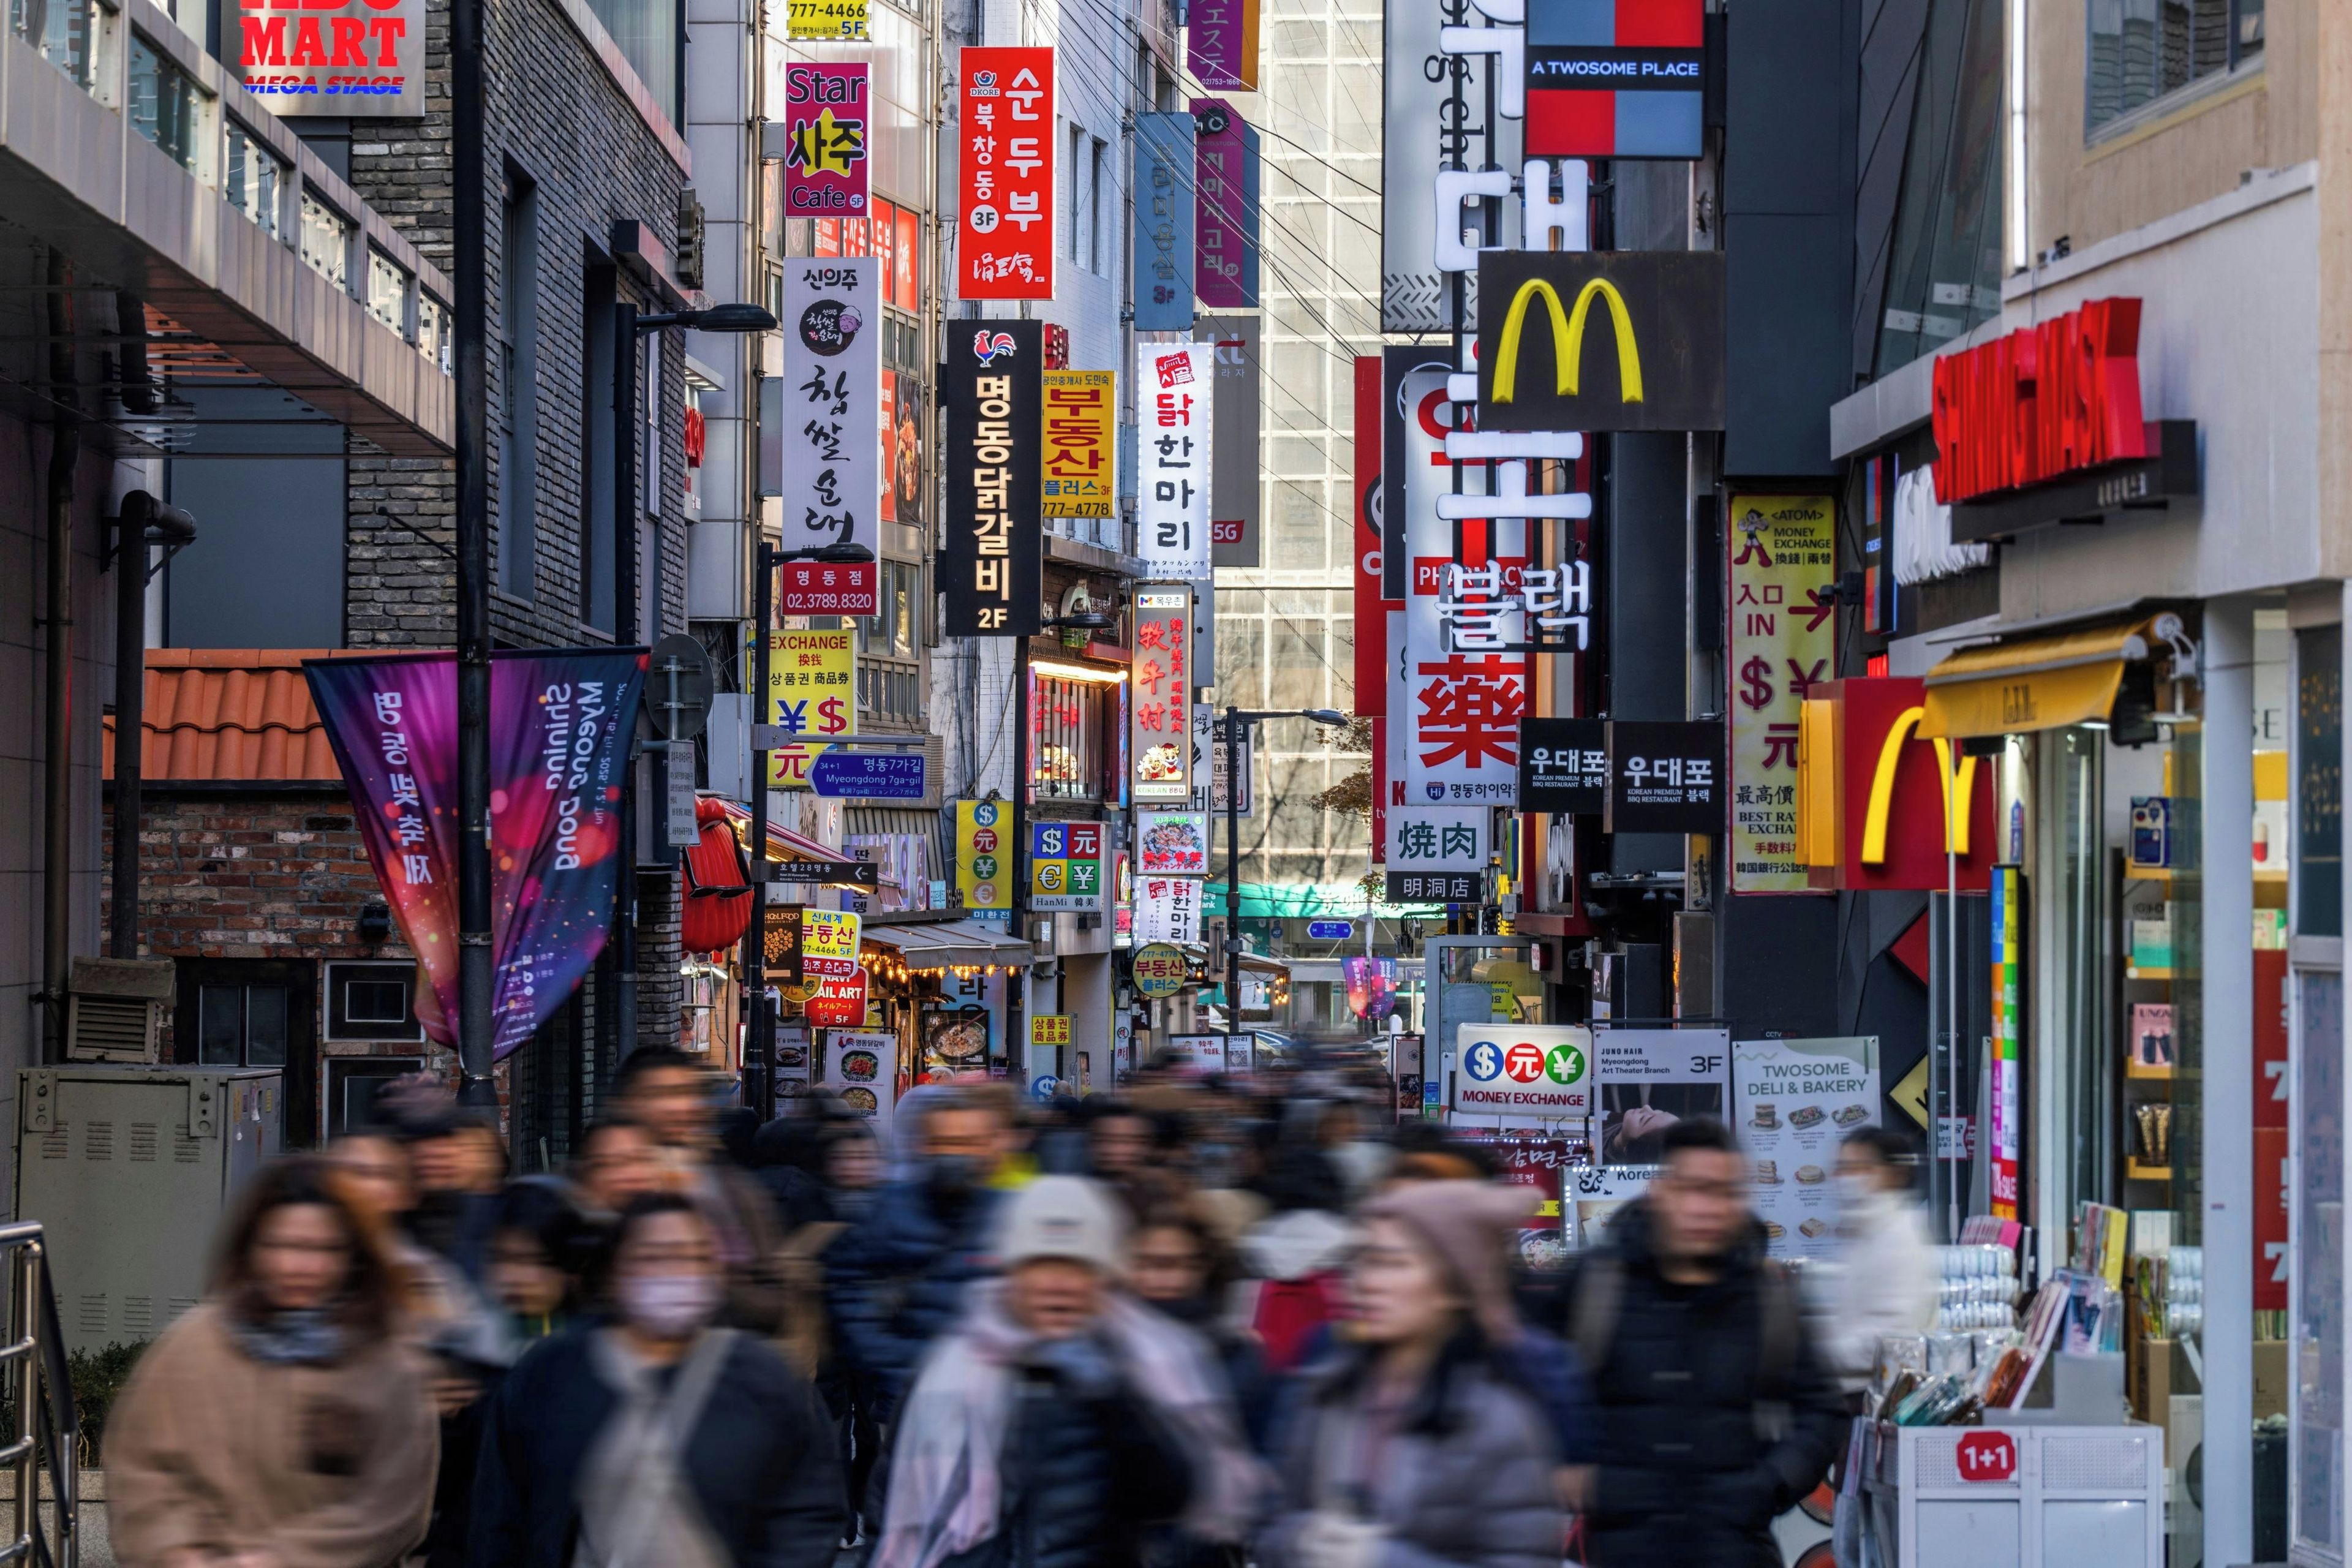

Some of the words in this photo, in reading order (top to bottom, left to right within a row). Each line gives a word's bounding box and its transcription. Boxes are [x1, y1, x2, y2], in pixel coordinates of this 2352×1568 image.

[790, 3, 865, 18] 777-4466
[841, 21, 864, 35] 5F
[239, 17, 406, 67] MART
[1532, 62, 1545, 75] A
[1548, 62, 1637, 75] TWOSOME
[1642, 62, 1698, 76] PLACE
[241, 75, 318, 95] MEGA
[324, 75, 405, 95] STAGE
[786, 68, 866, 104] Star
[970, 88, 1000, 96] DKORE
[786, 119, 865, 170] 사주
[972, 103, 998, 201] 북창동
[1005, 67, 1044, 233] 순두부
[791, 184, 846, 208] Cafe
[850, 196, 863, 206] 5F
[974, 211, 996, 227] 3F
[1203, 152, 1225, 276] 치마저고리
[1226, 265, 1238, 274] 3F
[802, 268, 858, 292] 신의주
[1153, 286, 1175, 305] 3F
[1207, 333, 1246, 365] kt
[1042, 375, 1082, 386] 공인중개사
[1085, 374, 1109, 386] 도민숙
[1044, 388, 1105, 477] 부동산
[799, 364, 854, 544] 찹쌀순대
[1153, 393, 1195, 551] 닭한마리
[972, 374, 1014, 601] 명동닭갈비
[1044, 480, 1099, 496] 플러스
[1101, 485, 1111, 496] 3F
[1042, 502, 1109, 516] 777-4778
[1213, 523, 1237, 540] 5G
[1774, 527, 1815, 537] MONEY
[1774, 539, 1831, 549] EXCHANGE
[796, 570, 862, 587] 명동점
[787, 594, 872, 609] 02.3789.8320
[1155, 597, 1182, 606] 목우촌
[1736, 584, 1783, 605] 入口
[1434, 559, 1590, 651] 블랙
[978, 608, 1008, 629] 2F
[1747, 613, 1775, 636] IN
[770, 636, 848, 650] EXCHANGE
[770, 672, 810, 686] 상품권
[815, 671, 850, 685] 商品券
[1137, 619, 1170, 732] 牧牛村
[864, 758, 921, 773] 명동7가길
[1529, 747, 1605, 775] 우대포
[1624, 756, 1713, 786] 우대포
[826, 774, 886, 786] Myeongdong
[1582, 775, 1603, 788] 블랙
[1449, 782, 1516, 798] 명동하이약
[1686, 788, 1709, 802] 블랙
[1739, 812, 1772, 822] BEST
[1776, 812, 1797, 822] RA
[976, 832, 994, 850] 元
[1396, 821, 1477, 860] 焼肉
[1403, 877, 1470, 898] 明洞店
[1036, 897, 1068, 907] HanMi
[1074, 897, 1095, 907] 韓美
[812, 912, 843, 924] 신세계
[1170, 881, 1193, 941] 닭한마리
[802, 924, 854, 946] 부동산
[802, 959, 821, 971] 의주
[824, 961, 852, 974] 순대국
[1135, 960, 1185, 978] 부동산
[814, 986, 837, 998] AIL
[838, 987, 863, 999] ART
[1142, 979, 1178, 991] 플러스
[817, 1001, 853, 1010] ネイルアート
[835, 1014, 849, 1023] 5F
[1035, 1018, 1068, 1030] 상품권
[855, 1038, 885, 1048] 명동닭갈비
[1035, 1030, 1068, 1042] 商品券
[1601, 1058, 1649, 1067] Myeongdong
[1690, 1056, 1722, 1073] 3F
[1762, 1063, 1850, 1078] TWOSOME
[1747, 1082, 1784, 1096] DELI
[1788, 1082, 1799, 1095] &
[1803, 1079, 1868, 1094] BAKERY
[1462, 1090, 1512, 1103] MONEY
[1513, 1092, 1585, 1107] EXCHANGE
[1964, 1445, 2009, 1469] 1+1
